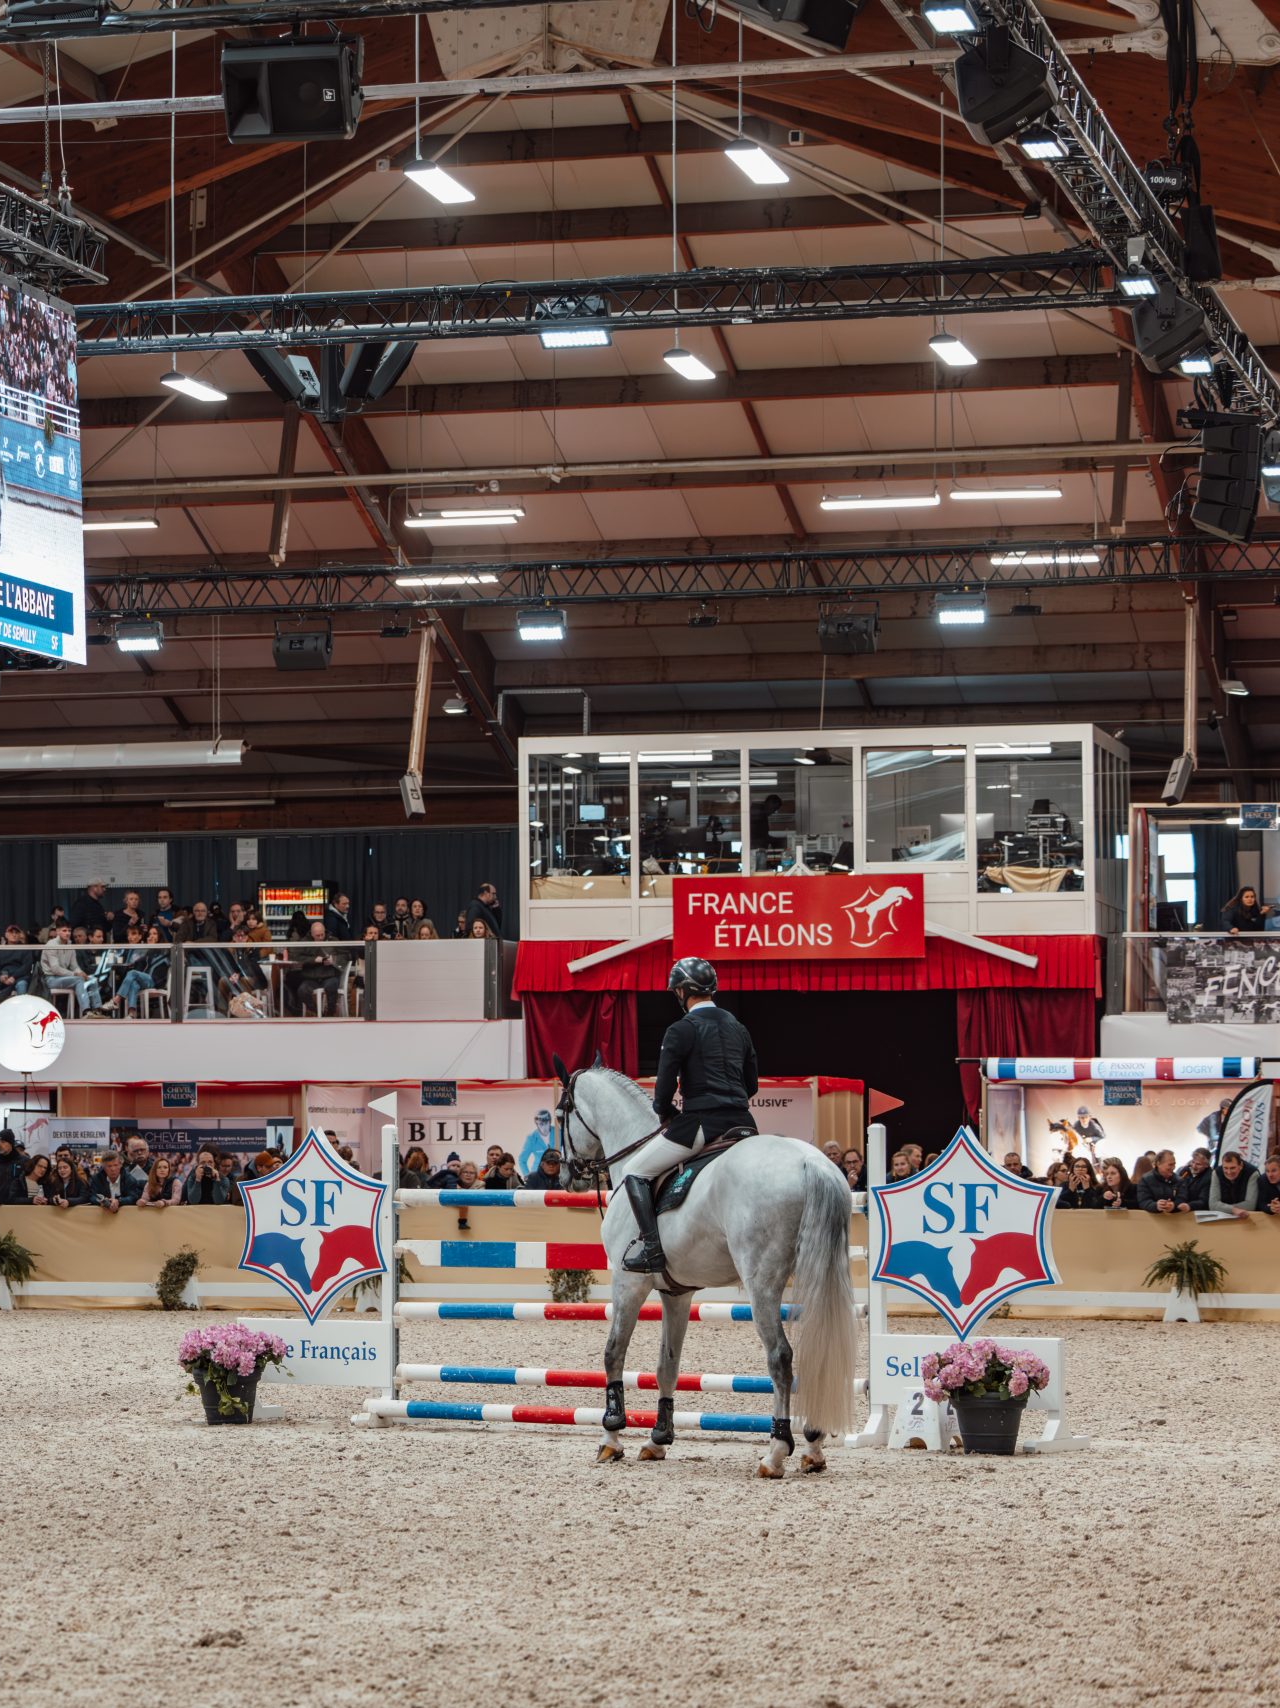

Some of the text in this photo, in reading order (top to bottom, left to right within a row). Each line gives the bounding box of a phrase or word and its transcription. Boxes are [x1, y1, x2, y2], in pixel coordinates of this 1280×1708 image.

[6, 582, 55, 620] L'ABBAYE
[3, 623, 12, 638] DE
[12, 625, 37, 645] SEMILLY
[51, 636, 58, 651] SF
[687, 892, 793, 915] FRANCE
[714, 919, 833, 948] ÉTALONS
[1204, 956, 1280, 1007] FENC
[1019, 1065, 1067, 1074] DRAGIBUS
[1110, 1062, 1146, 1070] PASSION
[1180, 1064, 1213, 1075] JOGRY
[52, 1130, 72, 1139] DEXTER
[144, 1131, 192, 1143] CHEVEL
[280, 1179, 343, 1227] SF
[922, 1183, 999, 1234] SF
[300, 1339, 377, 1366] Français
[886, 1355, 923, 1378] Sel
[911, 1392, 925, 1416] 2
